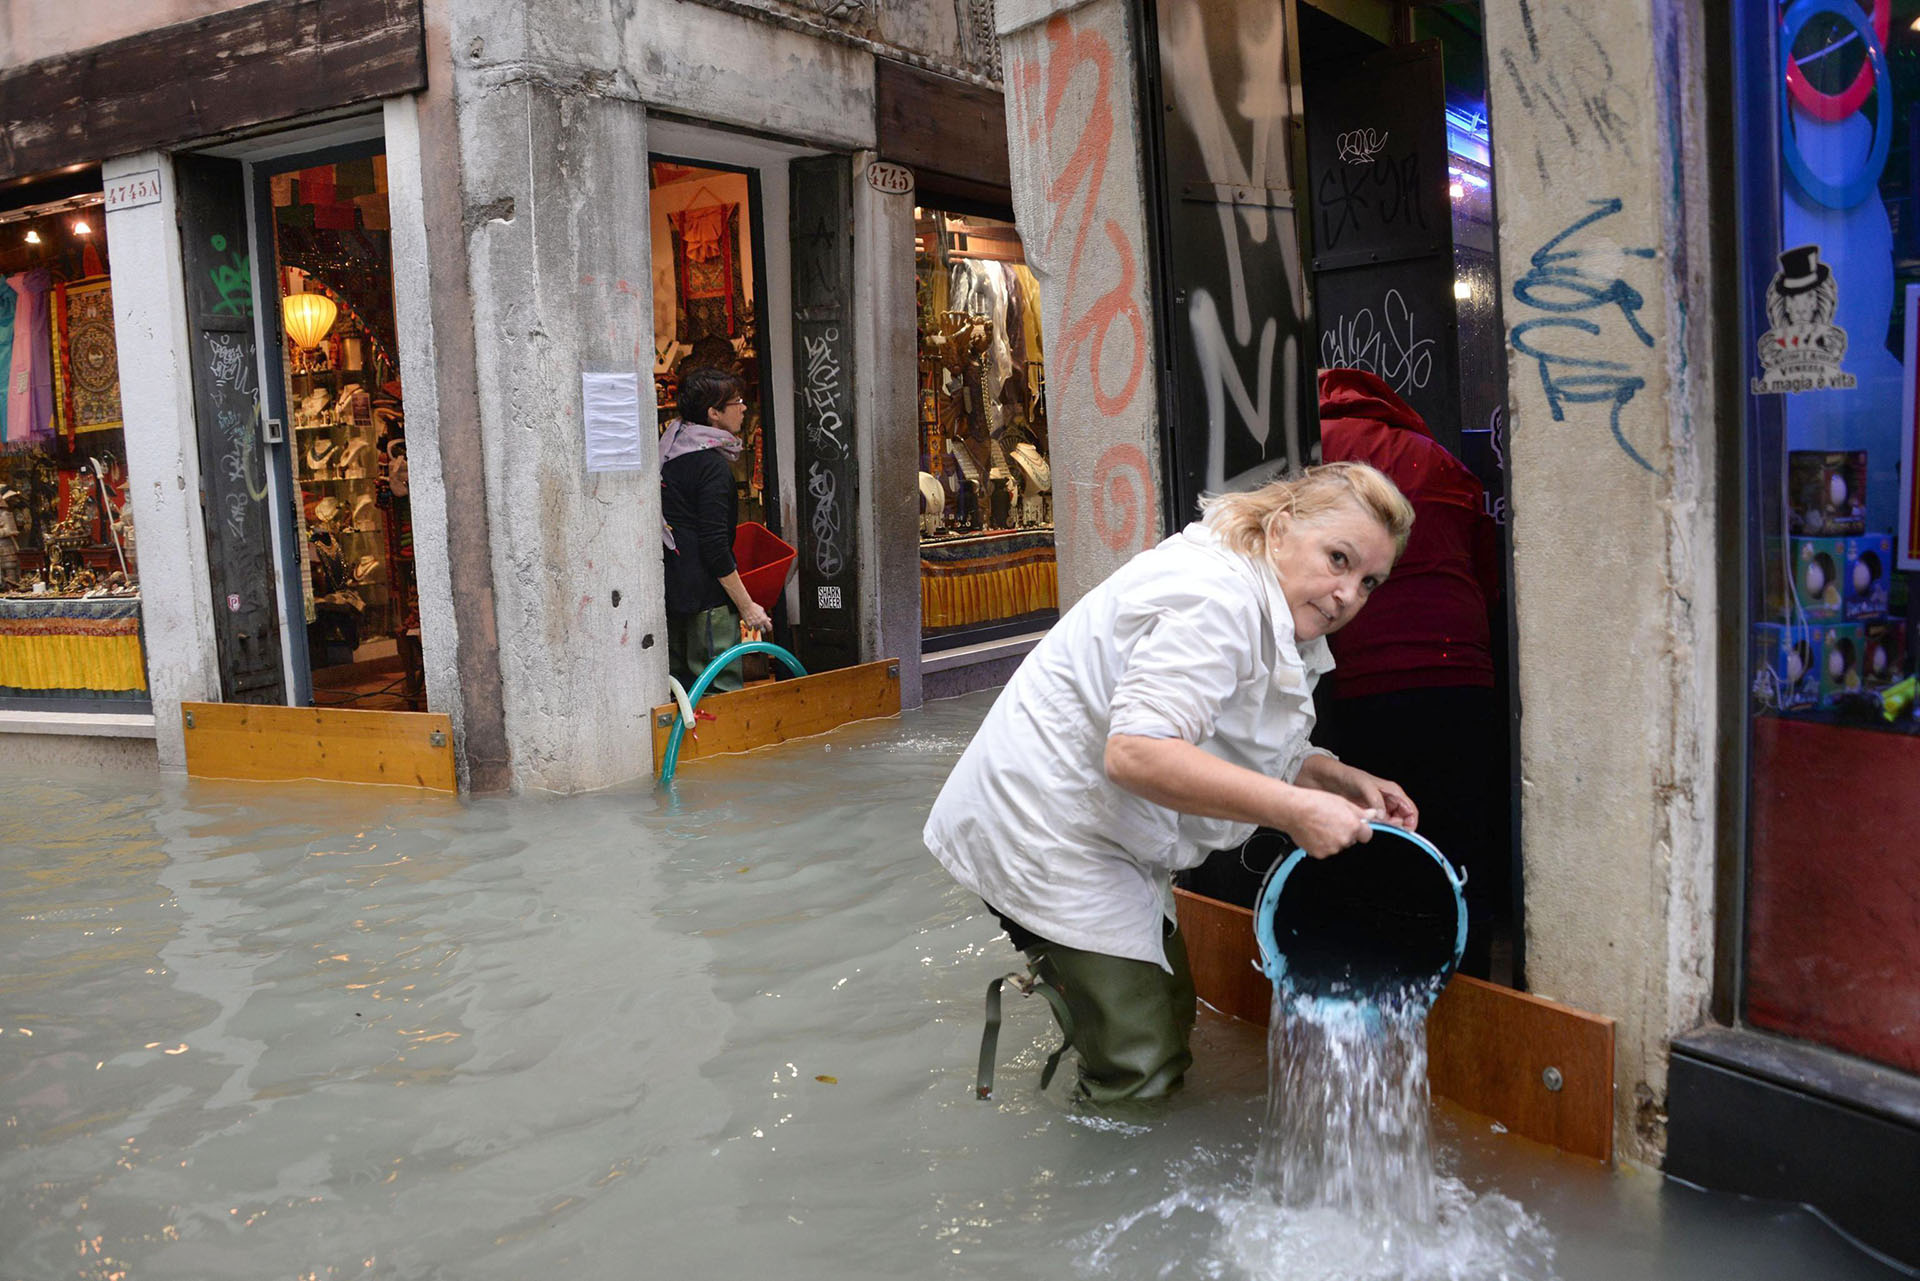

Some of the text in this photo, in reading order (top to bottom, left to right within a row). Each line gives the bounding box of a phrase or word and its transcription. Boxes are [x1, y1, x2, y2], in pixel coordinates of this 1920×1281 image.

[869, 165, 909, 190] 4745
[108, 180, 160, 204] 4745A
[1752, 379, 1768, 394] La
[1772, 374, 1813, 394] magia
[1829, 373, 1856, 389] vita
[818, 586, 840, 598] SHARK
